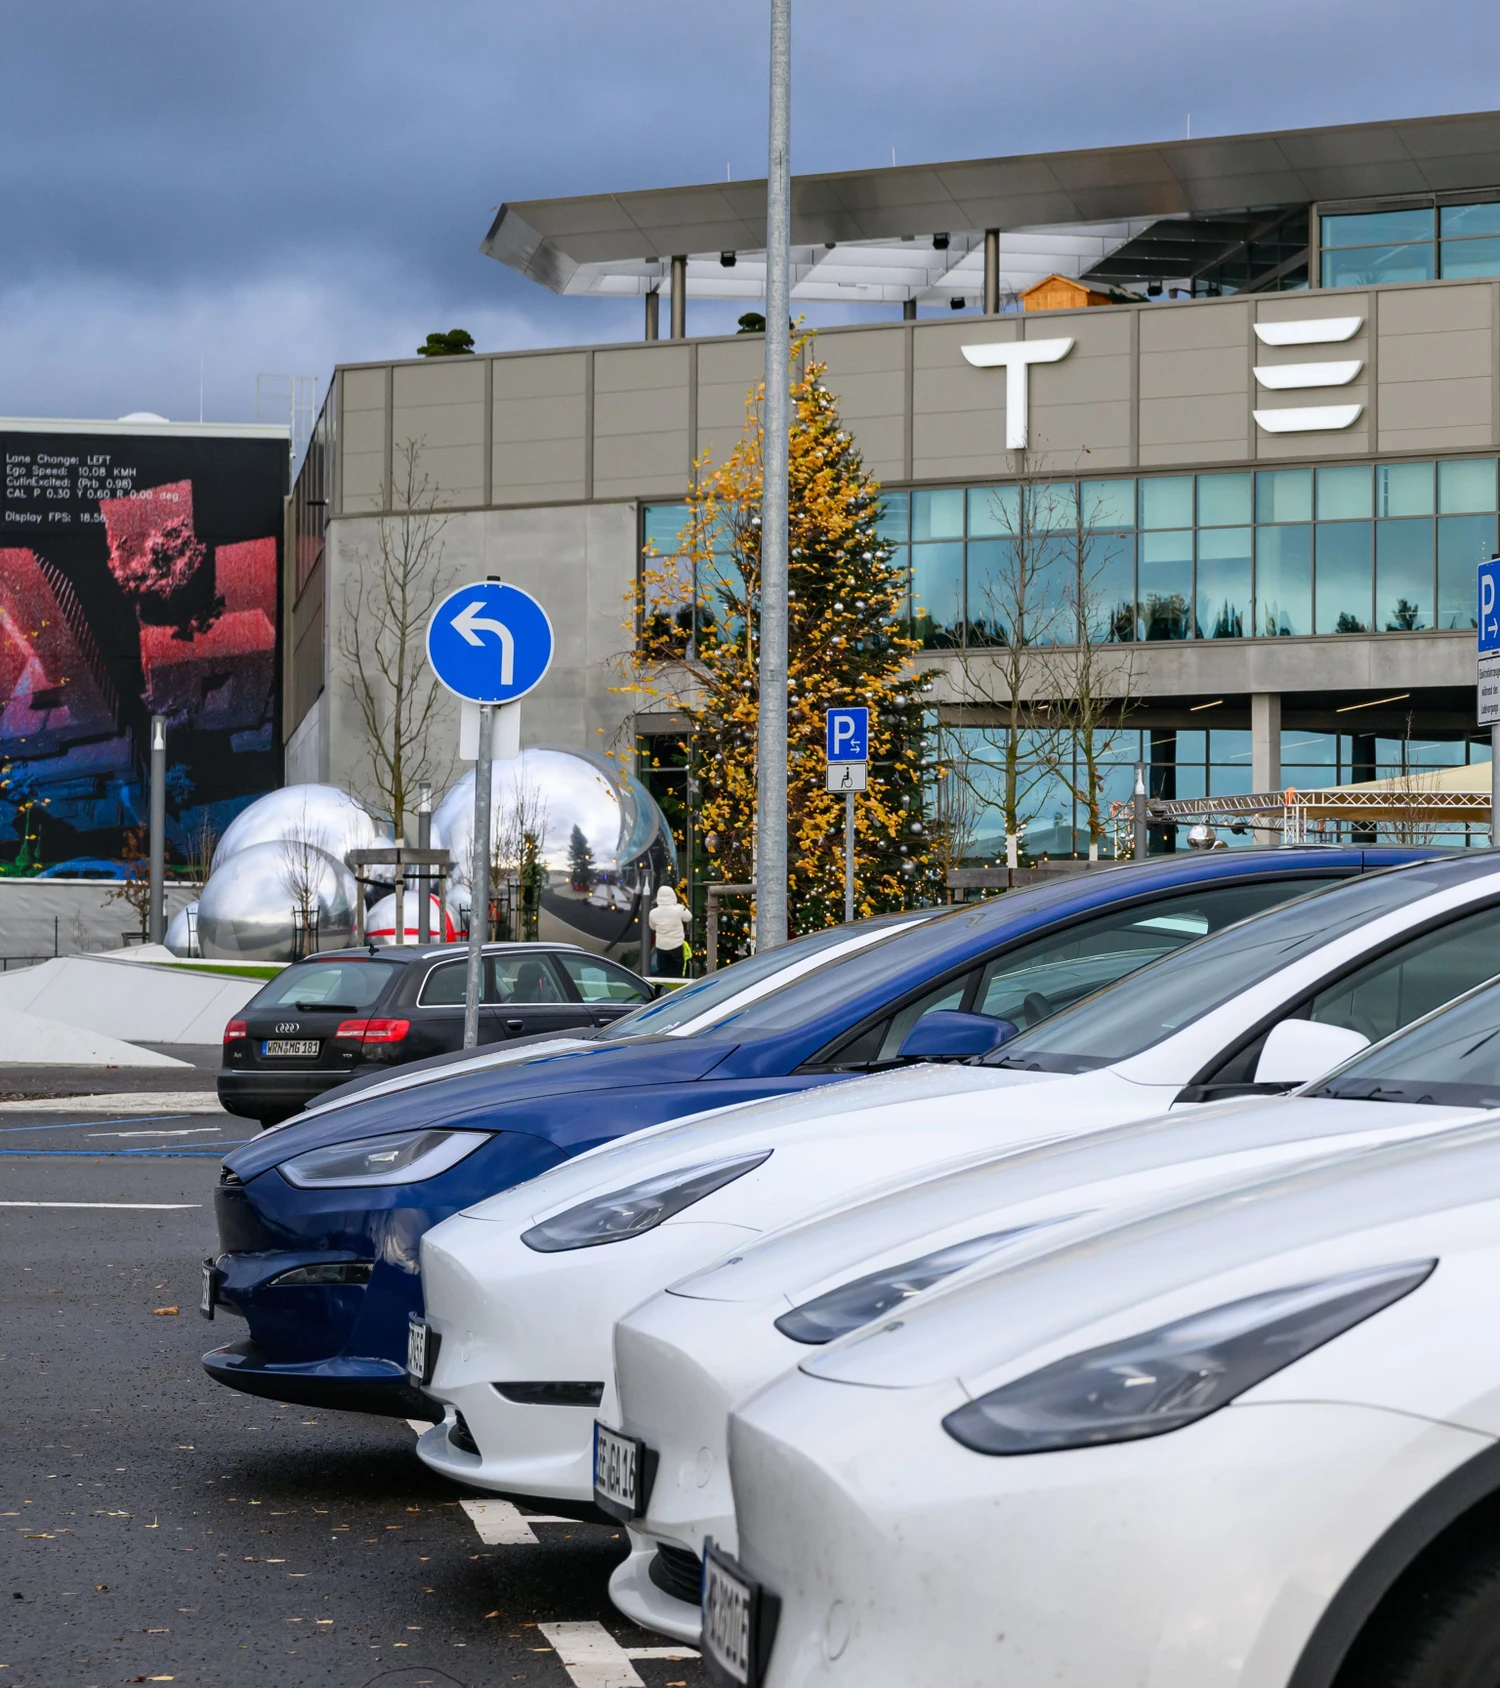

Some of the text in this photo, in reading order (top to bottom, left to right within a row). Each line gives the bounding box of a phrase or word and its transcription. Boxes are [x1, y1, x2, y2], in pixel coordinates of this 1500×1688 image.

[6, 453, 111, 467] Lane Change: LEFT
[6, 465, 26, 477] Ego
[32, 465, 68, 477] Speed:
[113, 468, 137, 477] KMH
[77, 478, 99, 489] (Prb
[6, 489, 27, 498] CAL
[34, 489, 40, 498] P
[77, 489, 83, 498] Y
[117, 490, 124, 499] R
[159, 492, 179, 502] deg
[5, 511, 43, 524] Display
[48, 512, 71, 523] FPS:
[1482, 574, 1495, 641] P
[834, 715, 855, 755] P
[267, 1041, 318, 1054] WRN MG 181
